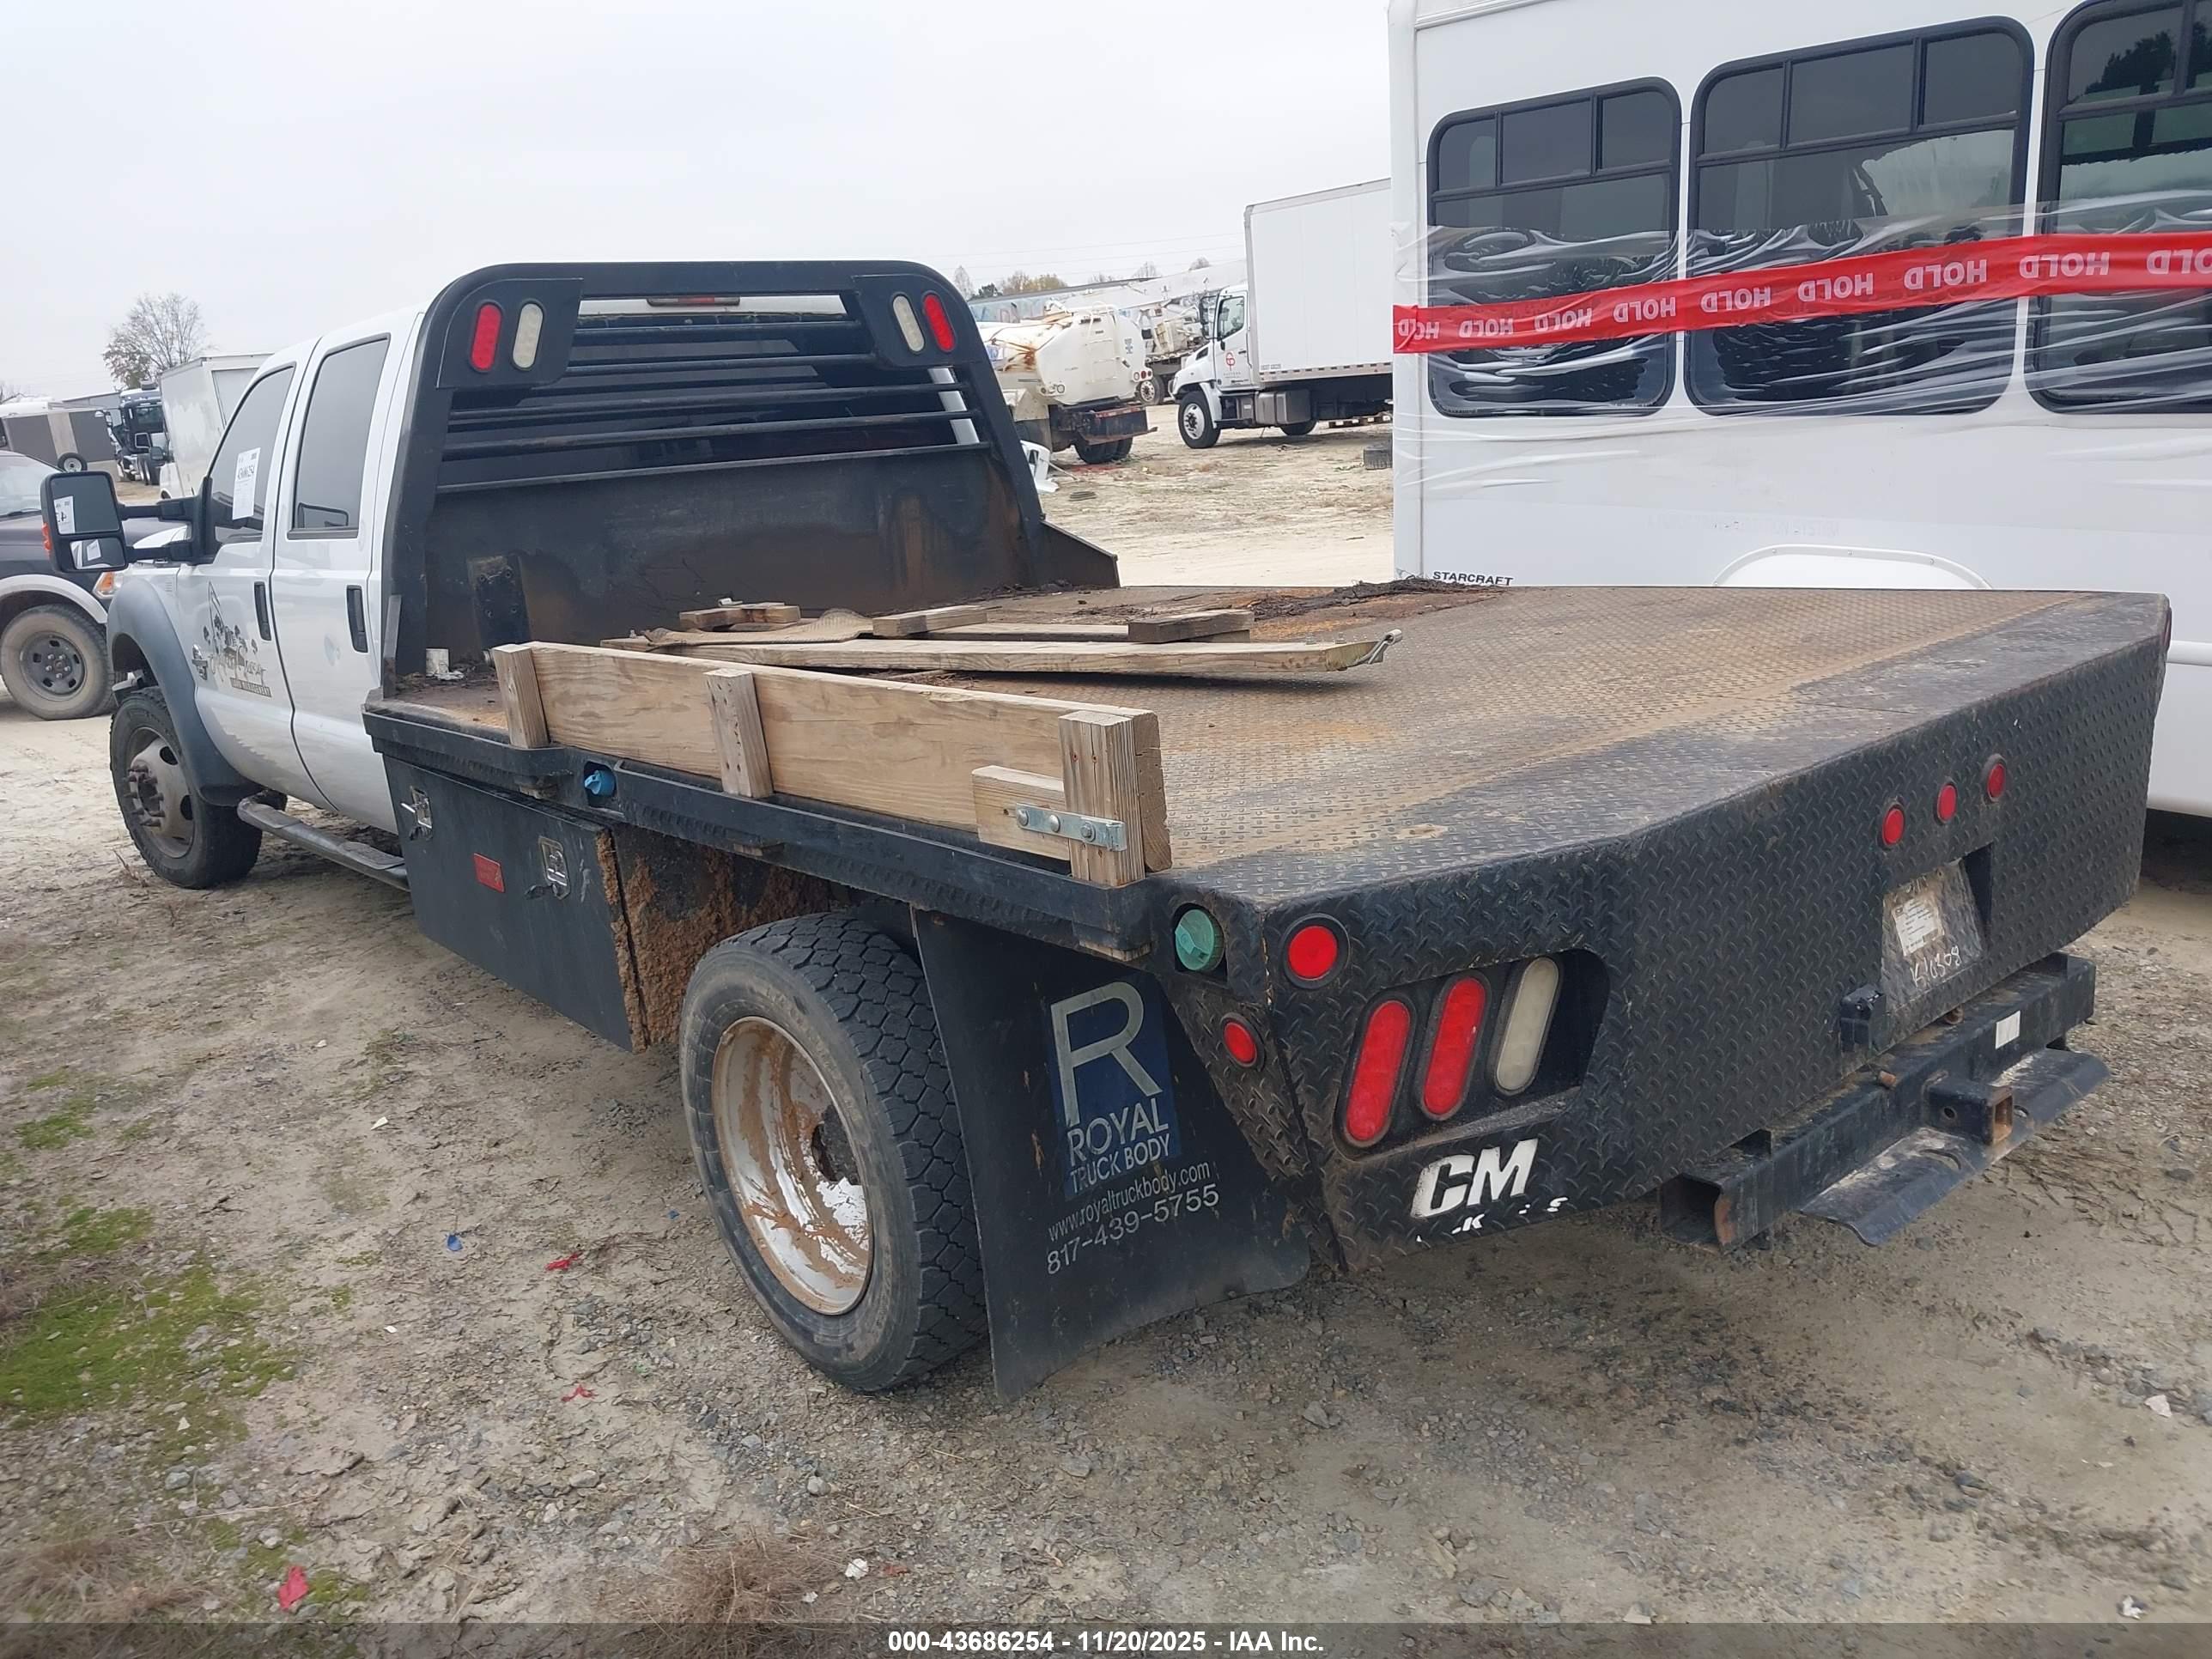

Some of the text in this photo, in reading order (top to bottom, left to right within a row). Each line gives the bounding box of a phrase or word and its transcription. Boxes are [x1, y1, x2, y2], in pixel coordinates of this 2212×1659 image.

[1460, 319, 1513, 338] HOLD
[1534, 307, 1592, 332] HOLD
[1613, 297, 1676, 323] HOLD
[1700, 287, 1771, 313] HOLD
[1797, 272, 1874, 302] HOLD
[1903, 259, 1988, 291] HOLD
[2019, 252, 2110, 279] HOLD
[2147, 247, 2212, 275] OLD
[1432, 571, 1513, 586] STARCRAFT
[1050, 981, 1164, 1127] R
[1066, 1097, 1169, 1166] ROYAL
[1070, 1133, 1170, 1194] TRUCK BODY
[1047, 1161, 1210, 1243] www.royaltruckbody.com
[1409, 1138, 1539, 1218] CM
[1047, 1182, 1219, 1274] 817-439-5755
